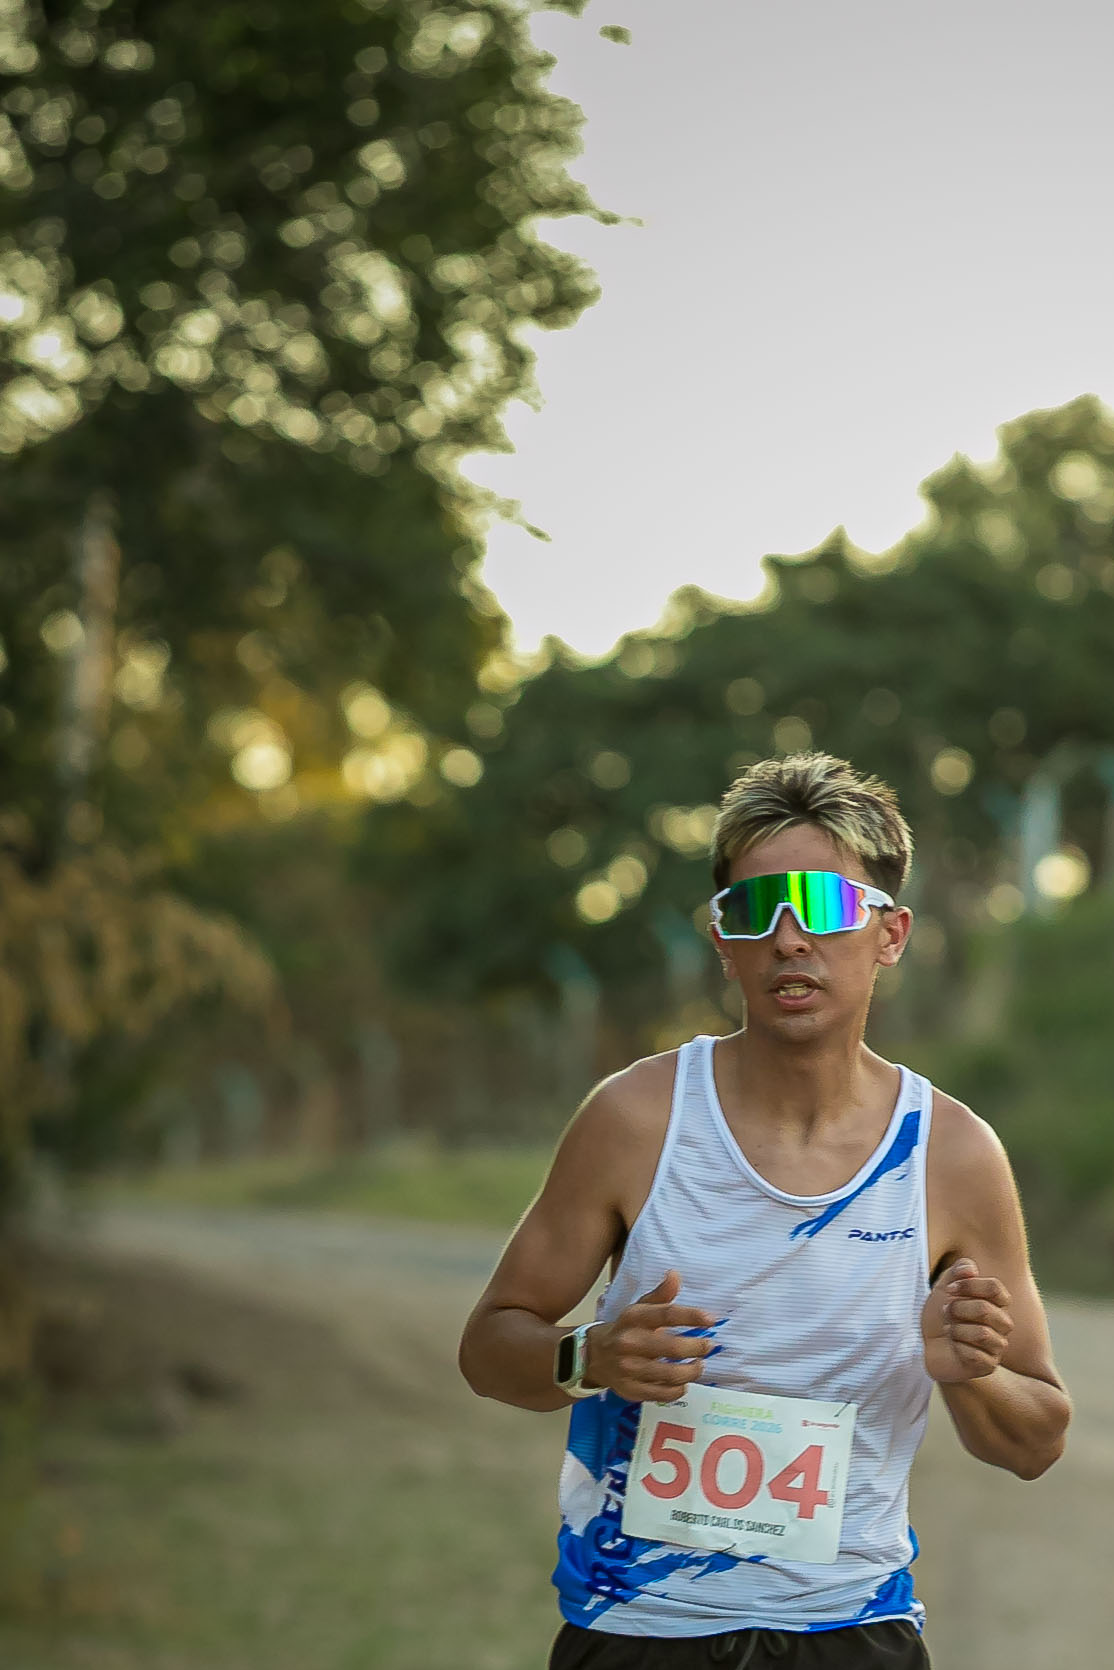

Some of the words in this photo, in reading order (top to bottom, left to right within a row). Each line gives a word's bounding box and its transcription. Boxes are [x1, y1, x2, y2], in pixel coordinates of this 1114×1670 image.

[703, 1413, 747, 1430] CORRE
[641, 1421, 829, 1519] 504
[671, 1509, 708, 1524] ROBERTO
[711, 1515, 744, 1530] CARLOS
[746, 1520, 786, 1536] SANCHEZ
